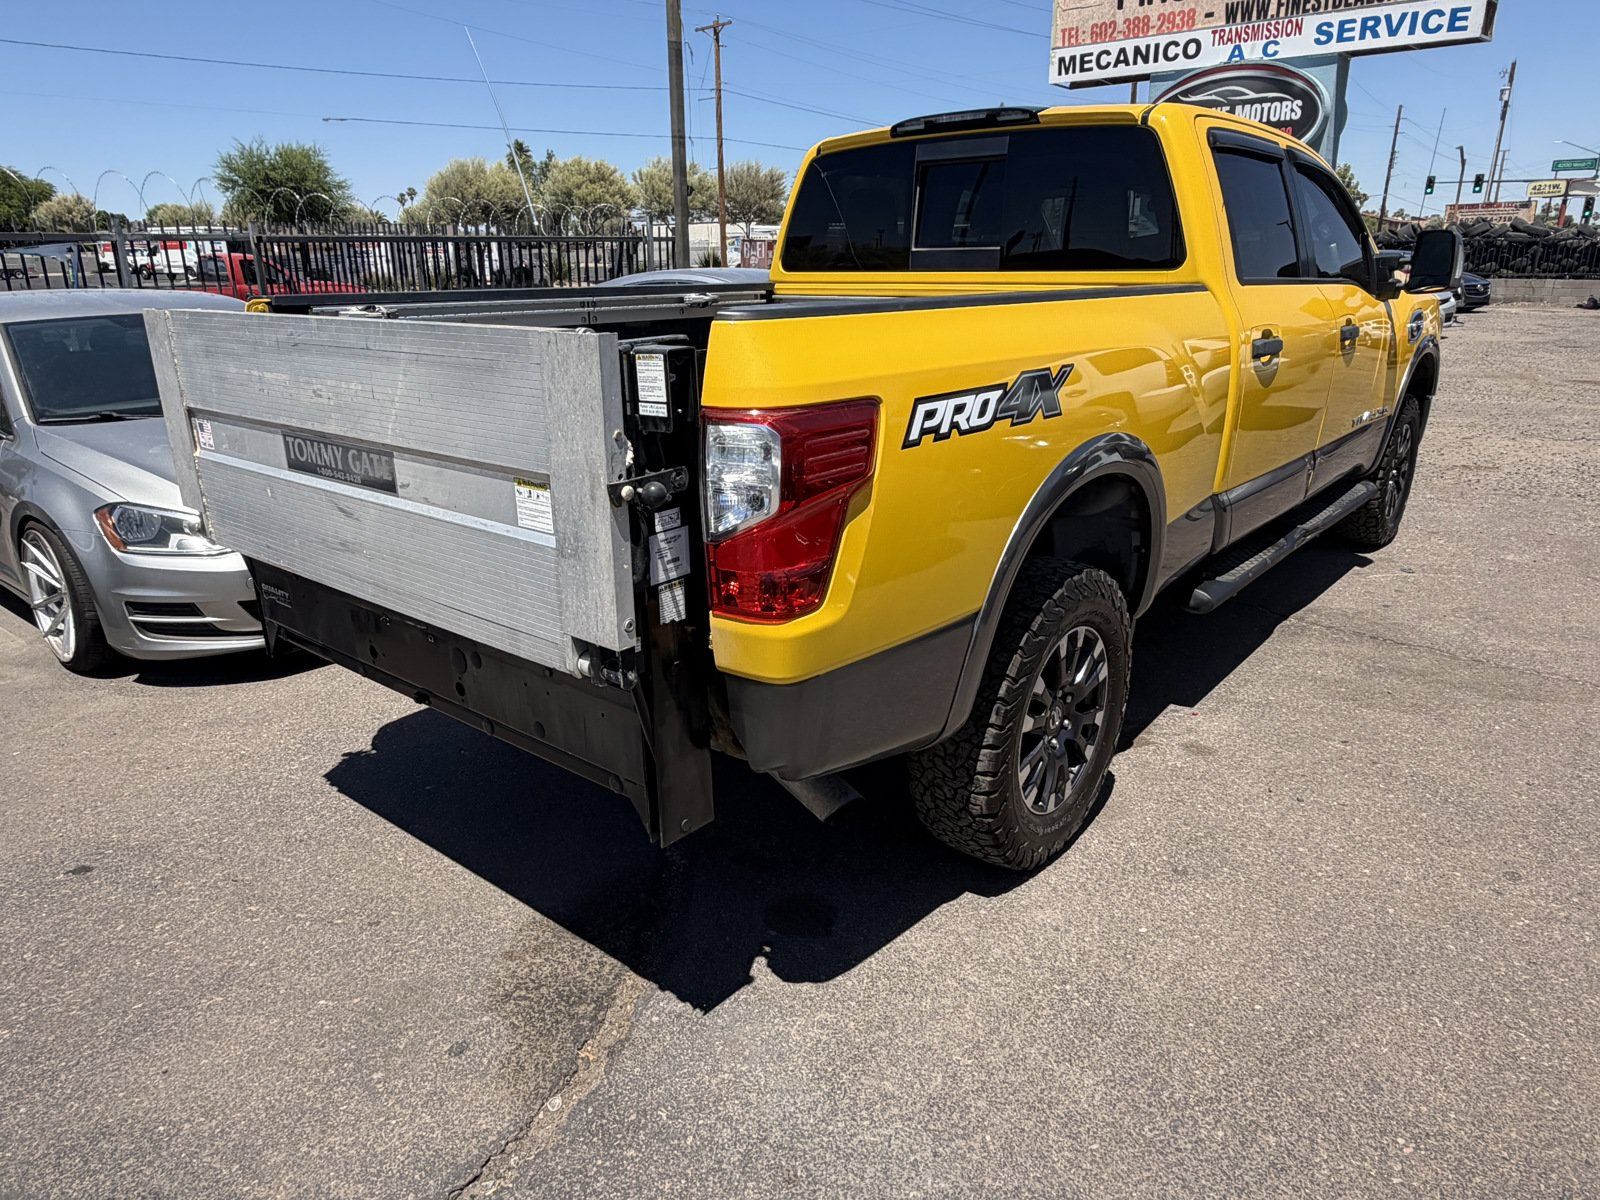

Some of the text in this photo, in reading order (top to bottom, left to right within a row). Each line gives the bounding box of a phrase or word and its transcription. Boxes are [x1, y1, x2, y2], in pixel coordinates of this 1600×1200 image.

[1057, 6, 1472, 77] MECANICO TRANSMISSION SERVICE
[1090, 8, 1197, 43] 602-388-2938
[1261, 39, 1281, 58] C
[1234, 99, 1303, 123] MOTORS
[285, 435, 394, 480] TOMMY GATE
